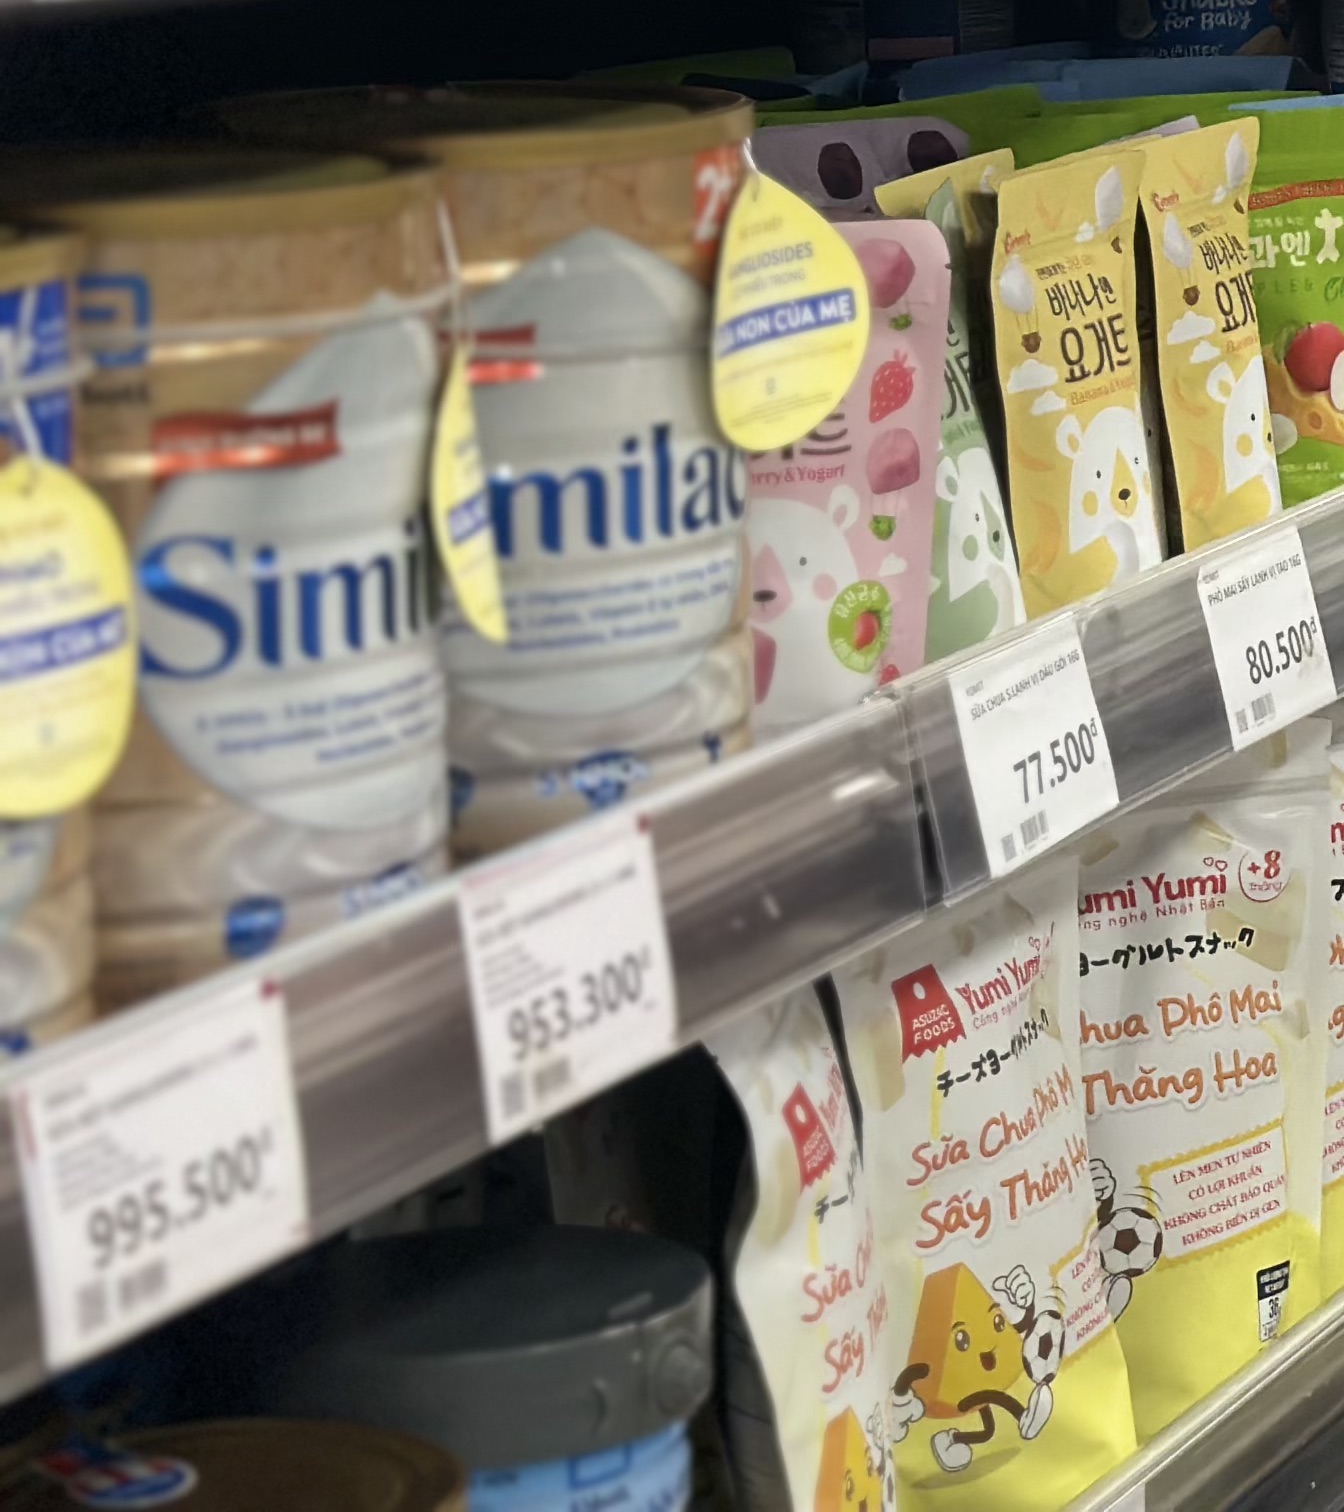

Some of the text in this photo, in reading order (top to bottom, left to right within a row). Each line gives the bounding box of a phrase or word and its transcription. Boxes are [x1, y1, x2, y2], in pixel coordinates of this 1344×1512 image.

[1163, 9, 1253, 32] for Baby
[775, 301, 815, 331] CỦA
[820, 294, 851, 323] MẸ
[488, 423, 746, 560] milac
[1246, 617, 1318, 685] 80.500đ
[1013, 718, 1099, 804] 77.500đ
[1247, 849, 1281, 880] +8
[1079, 872, 1227, 915] umi Yumi
[1155, 902, 1187, 919] Nhật
[956, 965, 1006, 1015] Yumi
[1080, 979, 1282, 1044] hua Phô Mai
[913, 1018, 956, 1044] FOODS
[1082, 1049, 1277, 1116] Thăng Hoa
[907, 1133, 970, 1186] Sữa
[980, 1108, 1037, 1159] Chua
[1173, 1169, 1196, 1185] LÊN
[1197, 1160, 1223, 1177] MEN
[916, 1153, 1071, 1249] Sấy Thăng
[1164, 1208, 1207, 1230] KHÔNG
[1182, 1223, 1224, 1246] KHÔNG
[802, 1263, 853, 1323] Sữa
[822, 1328, 867, 1393] Sấy
